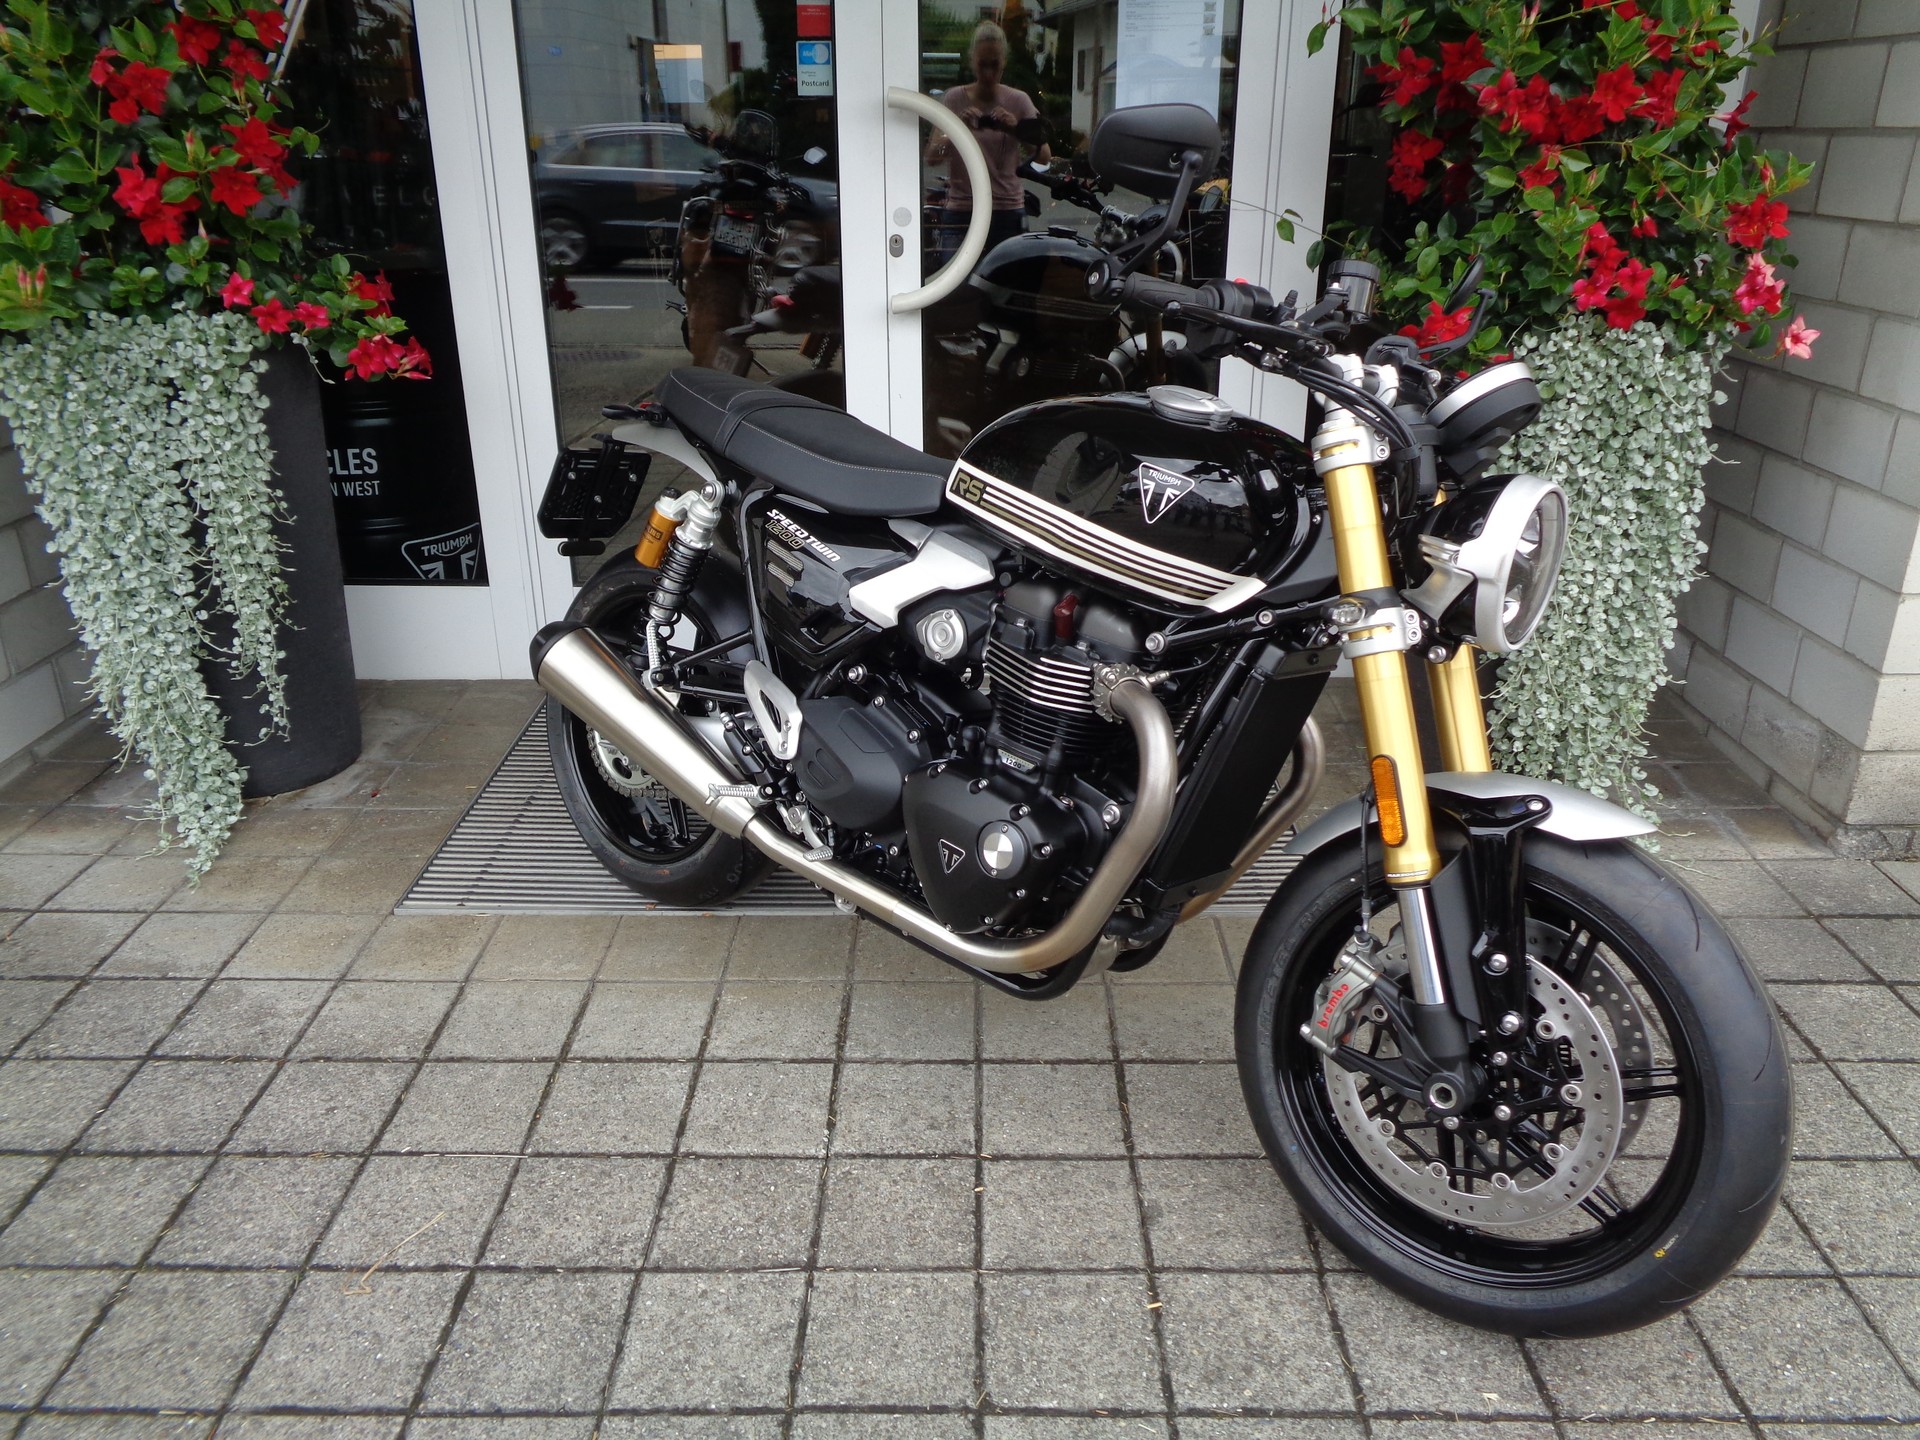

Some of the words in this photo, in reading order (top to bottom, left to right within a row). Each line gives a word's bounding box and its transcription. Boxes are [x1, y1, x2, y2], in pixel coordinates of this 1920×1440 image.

[341, 480, 380, 497] WEST
[952, 471, 985, 502] RS
[1148, 469, 1182, 487] TRIUMPH
[420, 533, 472, 557] TRIUMPH
[764, 519, 806, 549] 1200
[766, 508, 809, 539] SPEED
[805, 535, 841, 562] TWIN
[1316, 983, 1350, 1029] brembo
